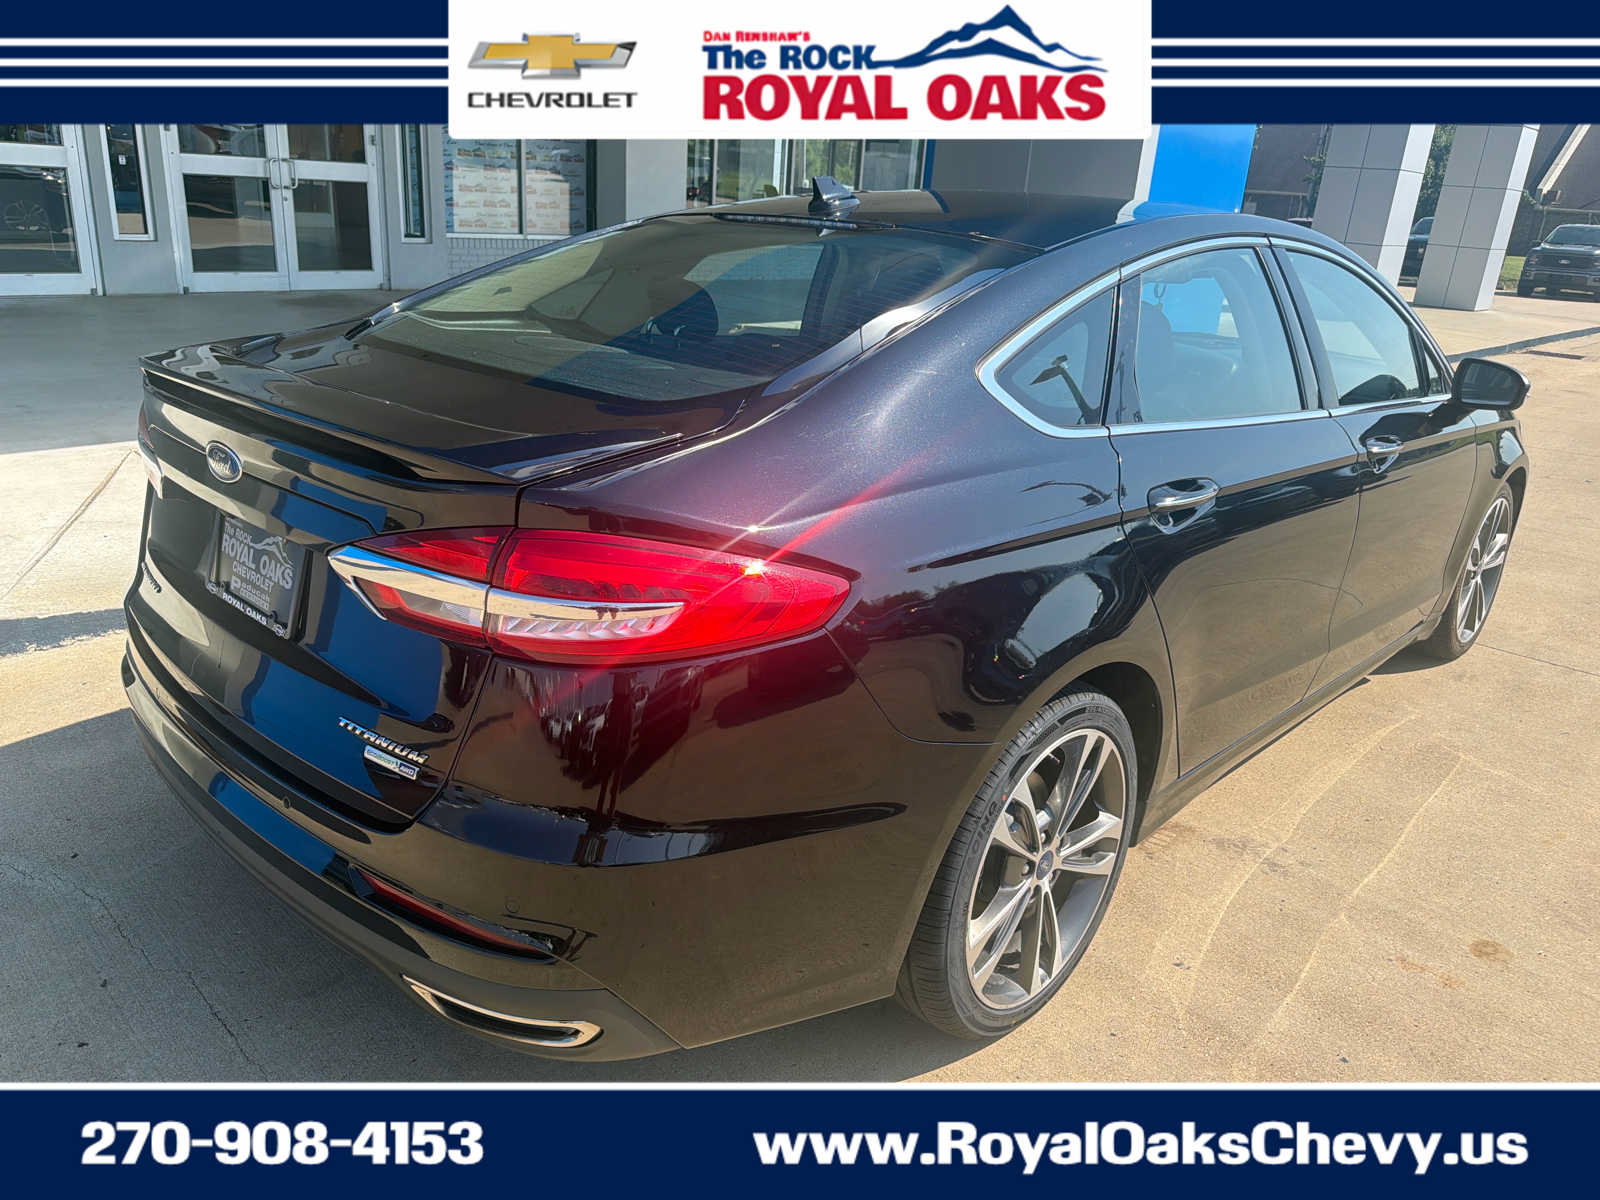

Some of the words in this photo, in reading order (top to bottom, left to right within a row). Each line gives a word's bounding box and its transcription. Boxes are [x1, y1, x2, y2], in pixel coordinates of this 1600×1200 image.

[221, 534, 256, 569] ROYAL
[260, 554, 293, 590] OAKS
[232, 560, 274, 592] CHEVROLET
[222, 592, 245, 612] ROYAL
[246, 607, 267, 626] OAKS
[338, 716, 430, 764] TITANIUM
